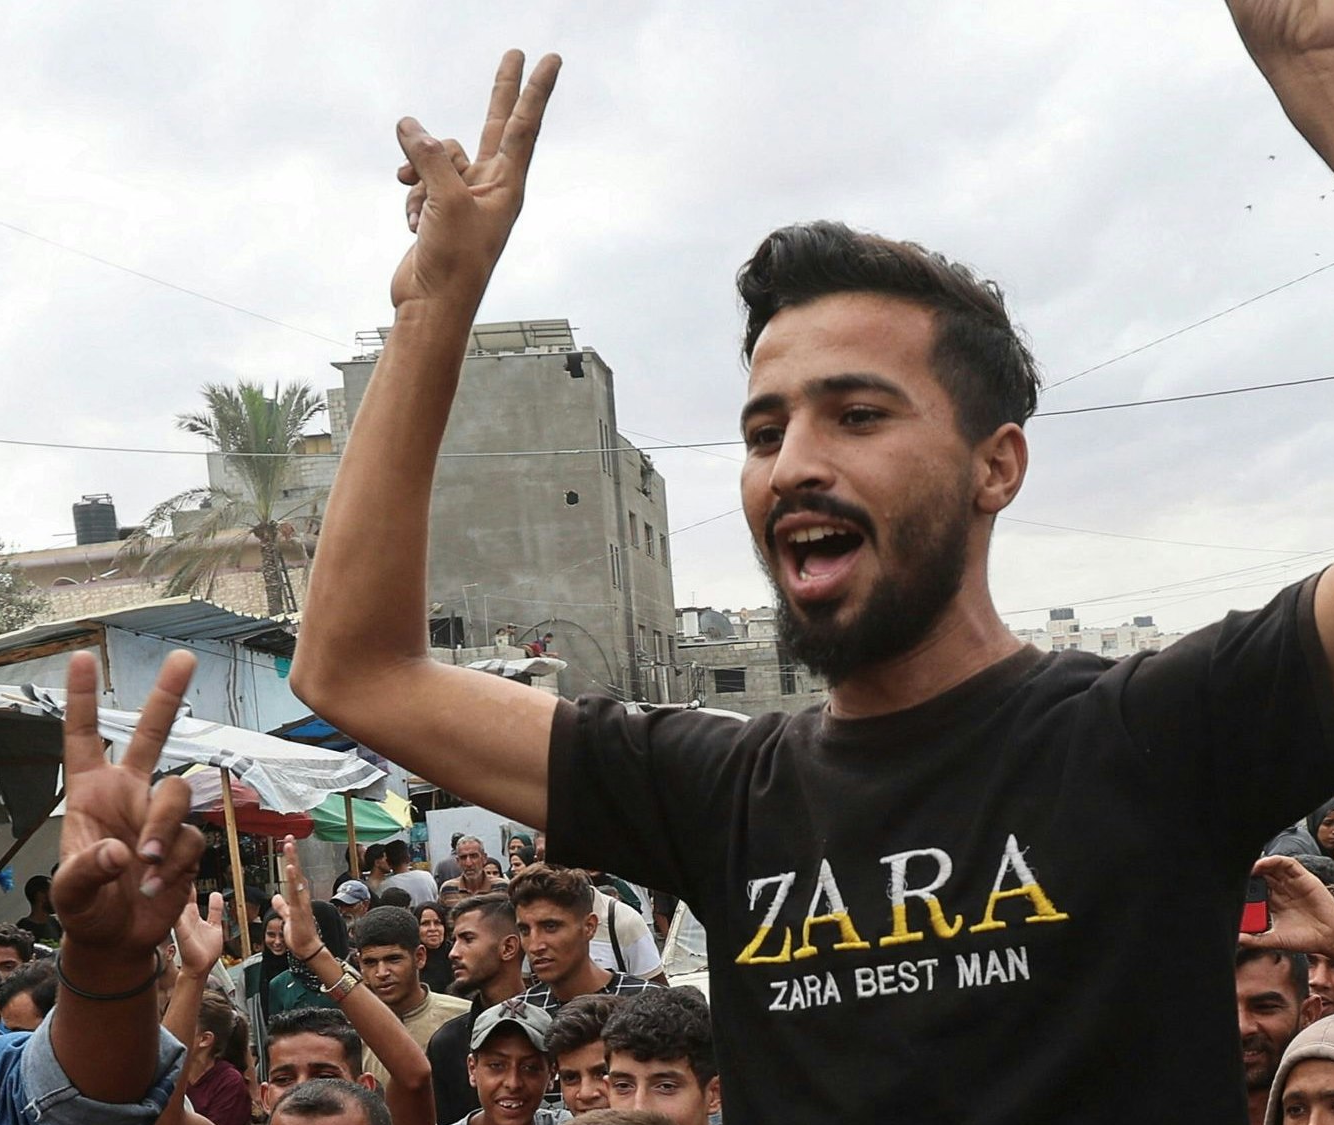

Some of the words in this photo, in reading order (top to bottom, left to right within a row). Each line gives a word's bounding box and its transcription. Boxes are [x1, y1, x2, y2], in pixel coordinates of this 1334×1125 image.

[735, 833, 1070, 964] ZARA
[768, 971, 842, 1012] ZARA
[854, 958, 939, 999] BEST
[955, 946, 1031, 989] MAN
